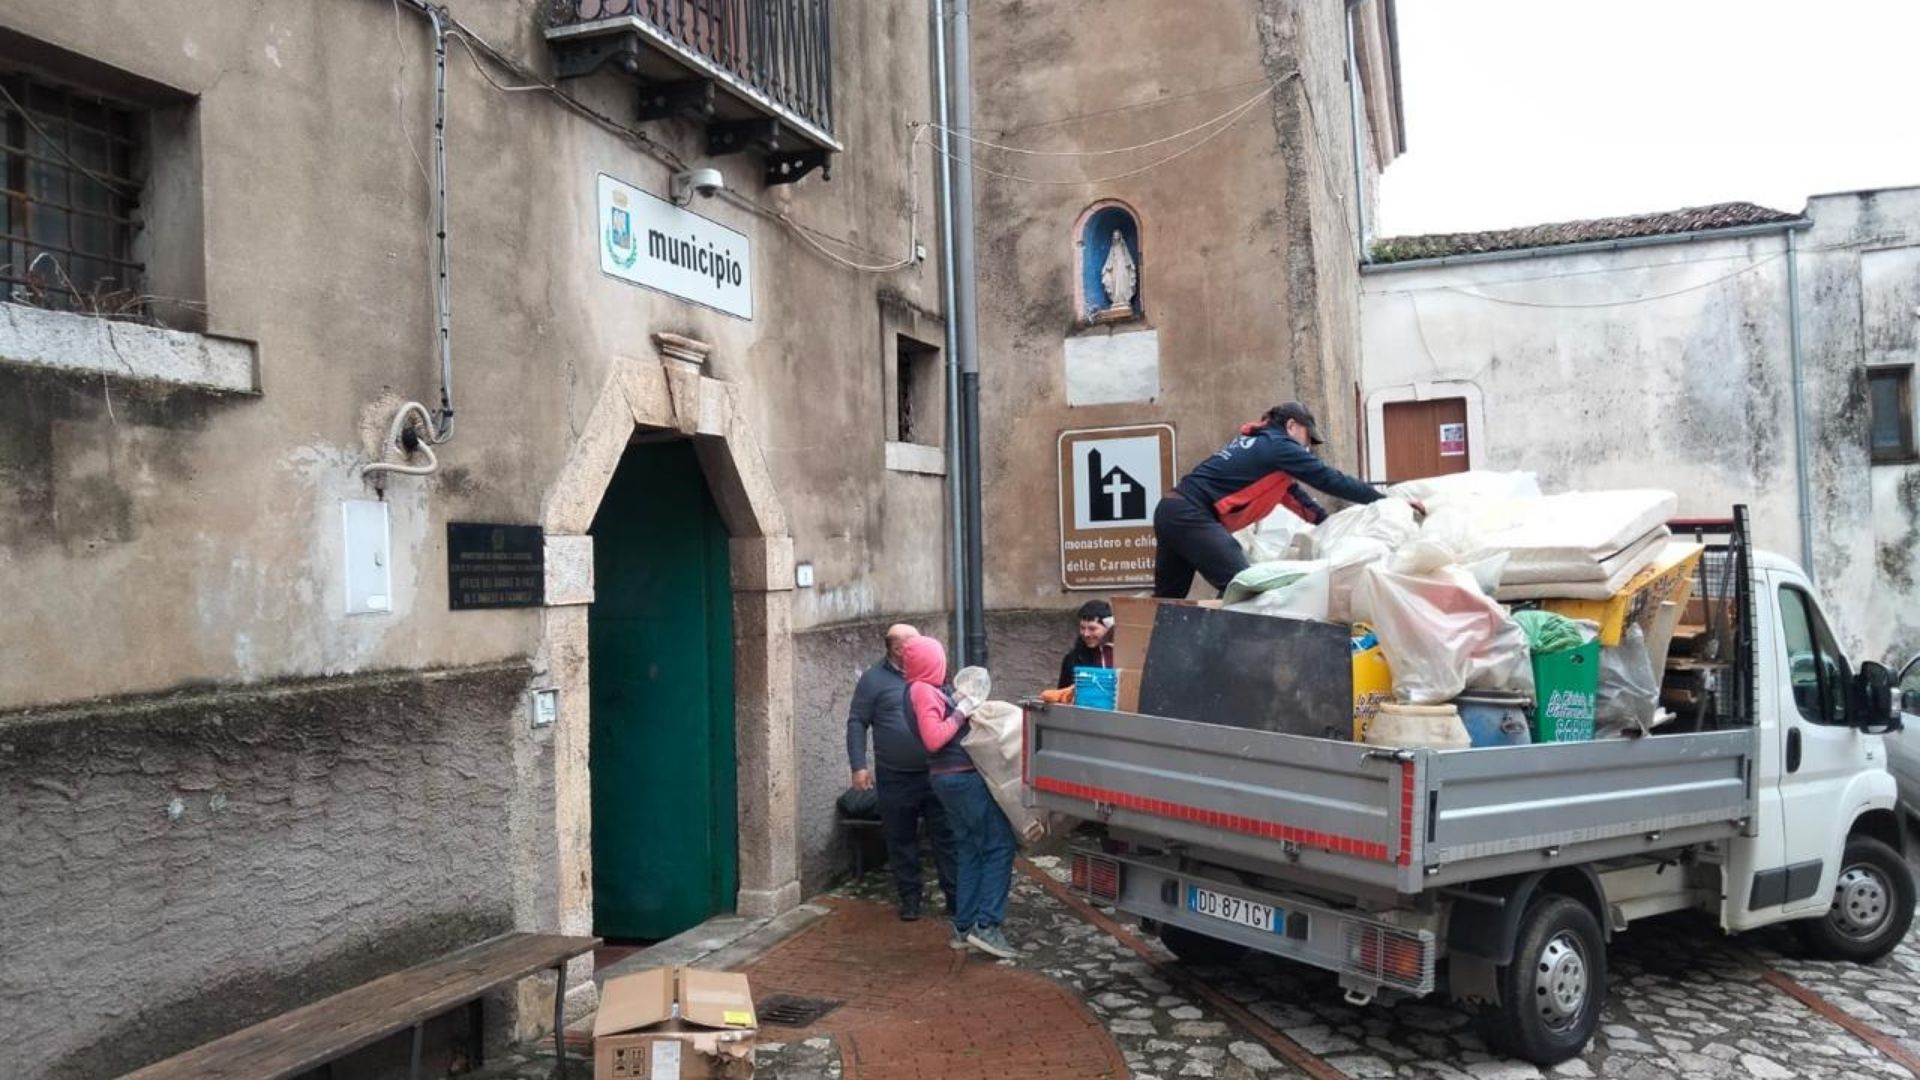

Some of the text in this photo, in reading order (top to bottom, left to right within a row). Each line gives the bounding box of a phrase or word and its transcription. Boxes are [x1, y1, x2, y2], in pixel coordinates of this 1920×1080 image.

[648, 228, 742, 290] municipio
[1065, 536, 1121, 550] monastero
[1124, 538, 1132, 548] e
[1066, 559, 1096, 573] delle
[1199, 891, 1273, 929] DD 871GY
